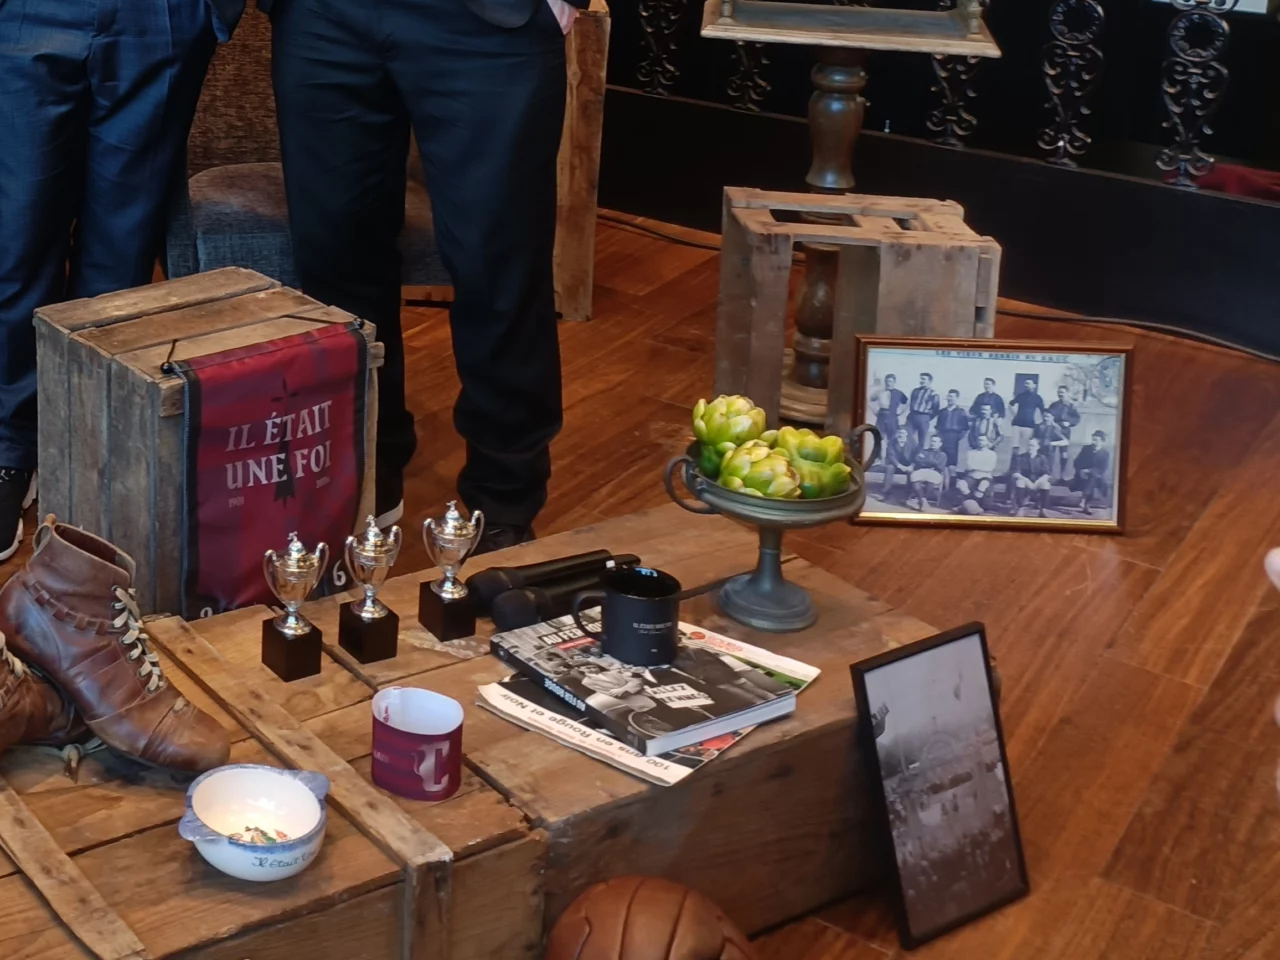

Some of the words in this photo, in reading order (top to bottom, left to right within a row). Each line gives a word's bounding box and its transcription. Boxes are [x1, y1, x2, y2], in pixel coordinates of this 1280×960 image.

[224, 424, 256, 453] IL
[262, 399, 333, 446] ÉTAIT
[225, 452, 288, 490] UNE
[293, 440, 332, 479] FOI
[332, 558, 348, 587] 6
[541, 633, 563, 645] AU
[559, 627, 585, 640] FER
[499, 692, 528, 709] Noir
[530, 708, 545, 718] et
[548, 715, 592, 739] Rouge
[596, 737, 613, 746] en
[646, 758, 671, 771] 100
